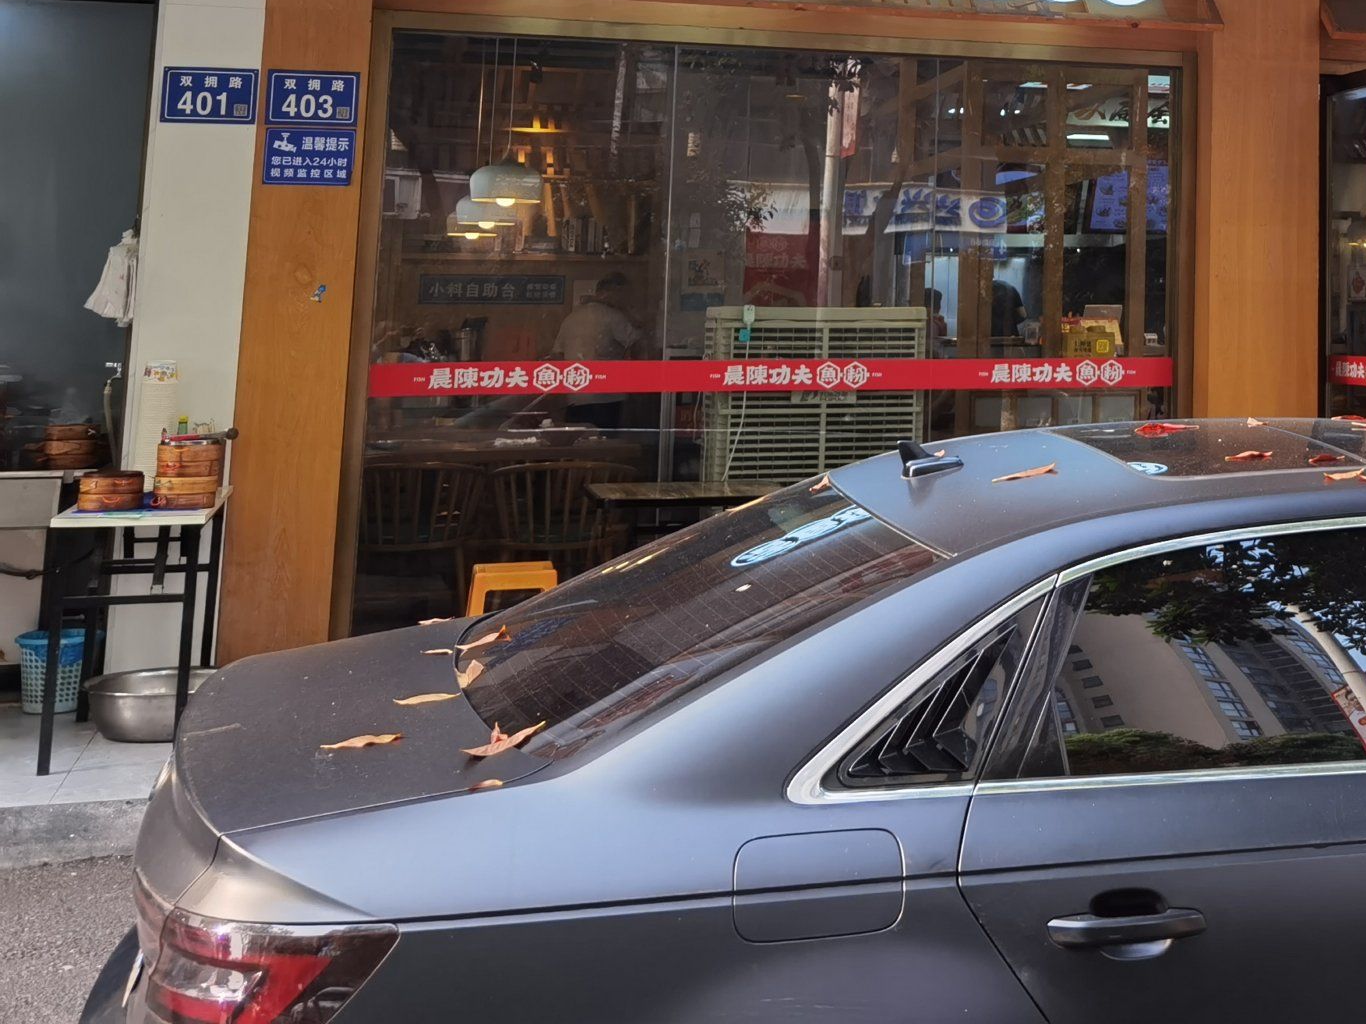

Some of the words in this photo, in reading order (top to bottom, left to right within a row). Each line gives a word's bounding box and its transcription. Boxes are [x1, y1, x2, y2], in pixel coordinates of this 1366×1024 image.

[180, 75, 243, 89] 双拥路
[283, 78, 345, 92] 双拥路
[177, 91, 228, 116] 401
[281, 93, 334, 118] 403
[301, 136, 349, 151] 温馨提示
[270, 156, 348, 167] 您已进入24小时
[270, 168, 347, 179] 视频监控区域
